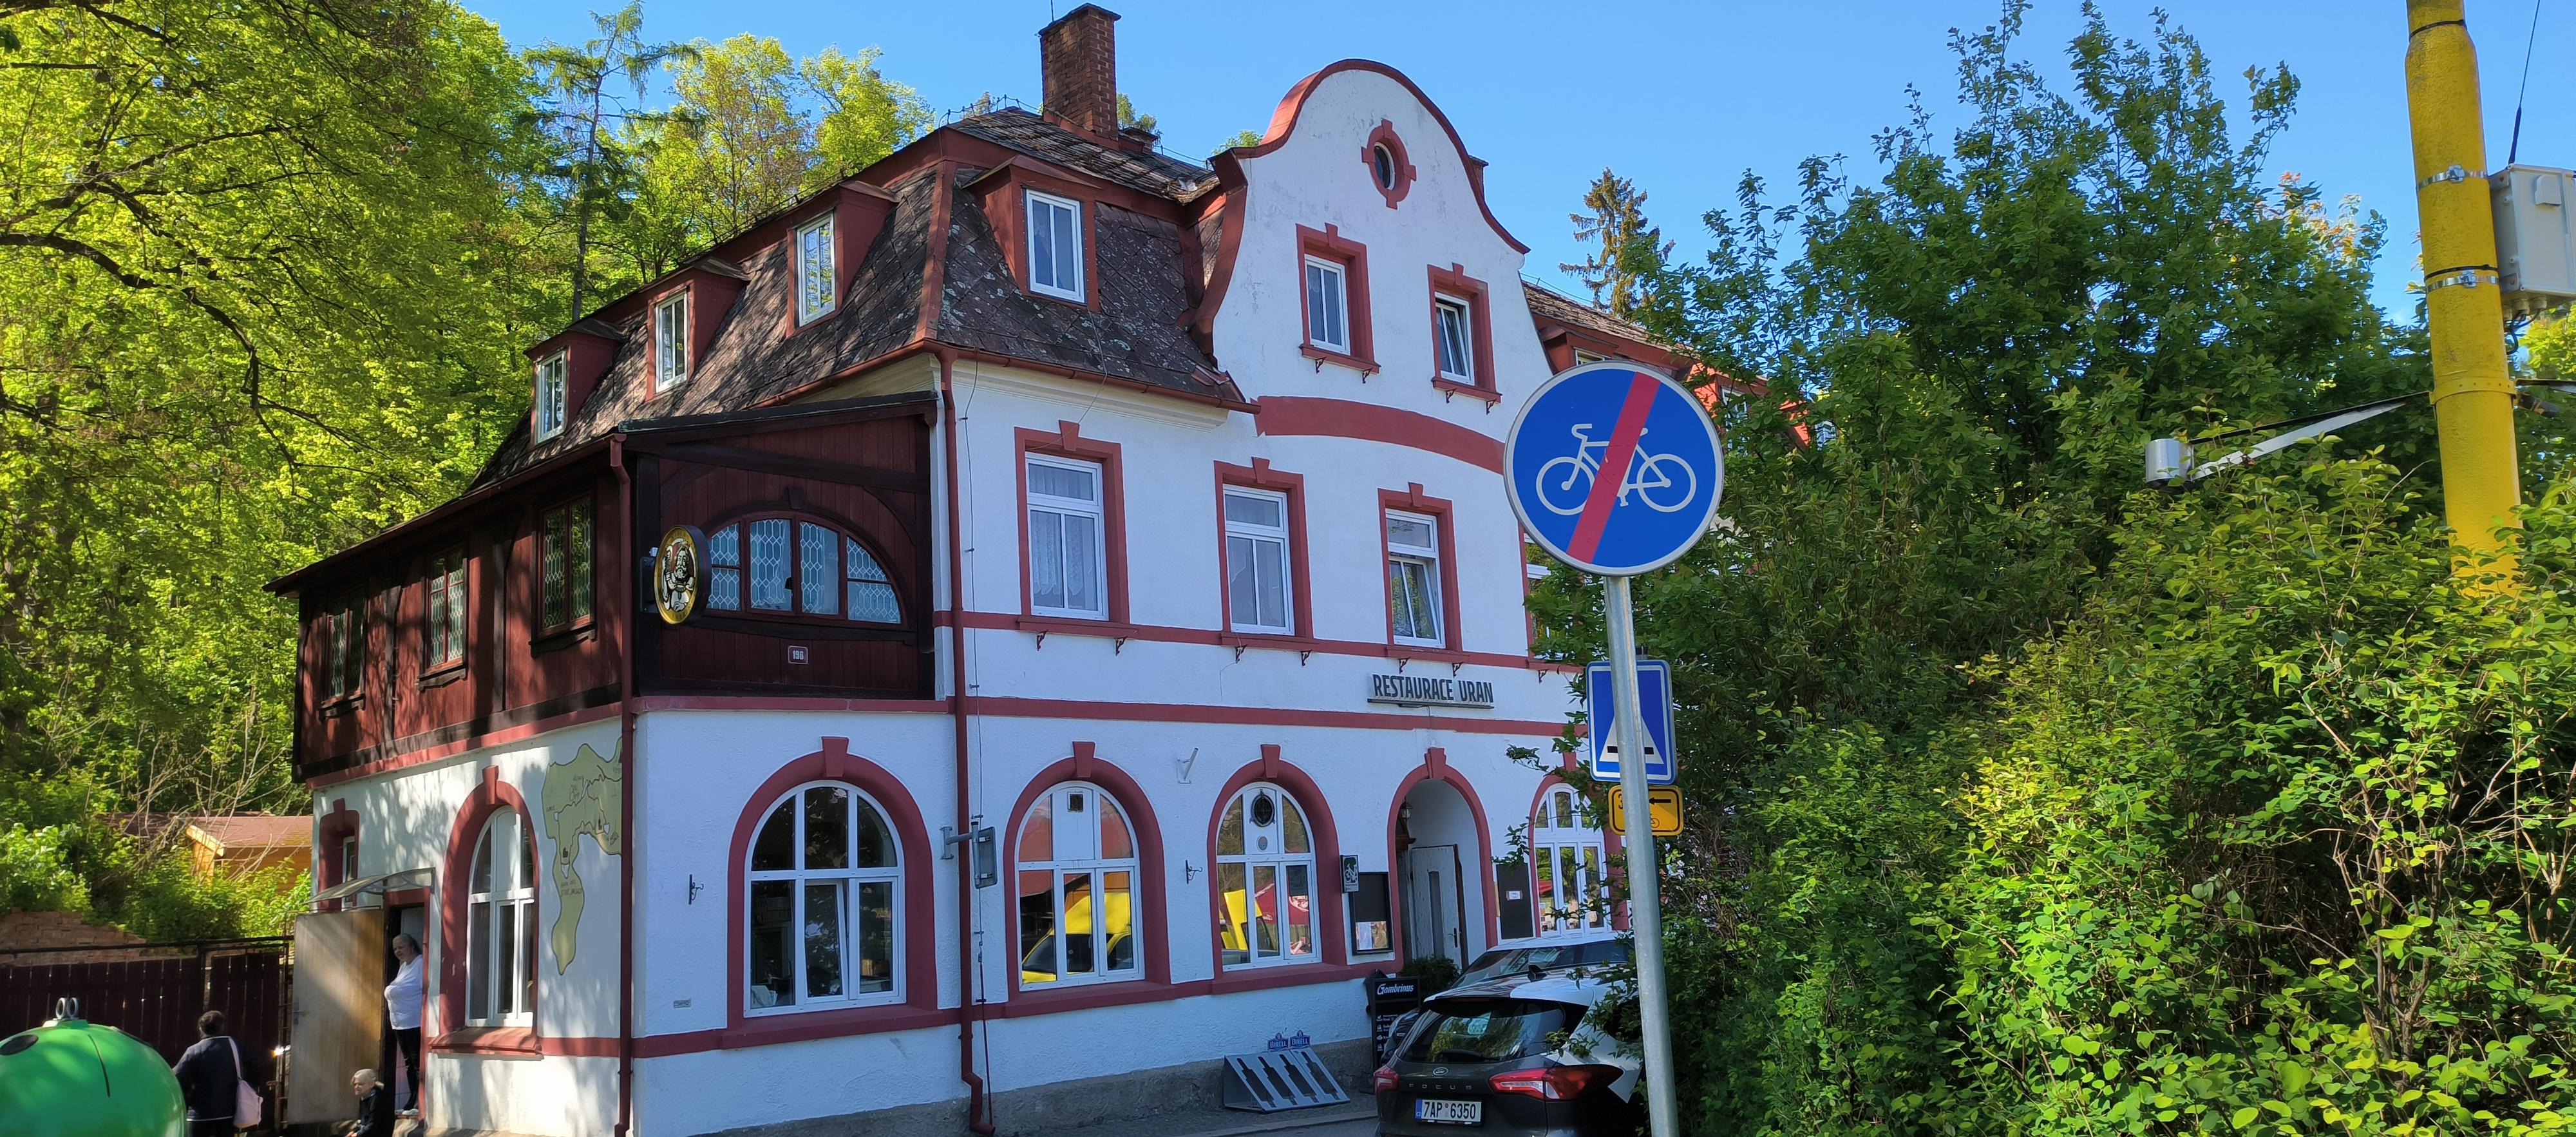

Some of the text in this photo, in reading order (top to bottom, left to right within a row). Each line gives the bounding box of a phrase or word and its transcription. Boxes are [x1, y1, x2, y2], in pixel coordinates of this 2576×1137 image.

[793, 650, 804, 660] 196
[1372, 674, 1494, 703] RESTAURACE URAN
[1377, 984, 1414, 995] Gambrinus
[1424, 1102, 1476, 1120] 7AP 6350
